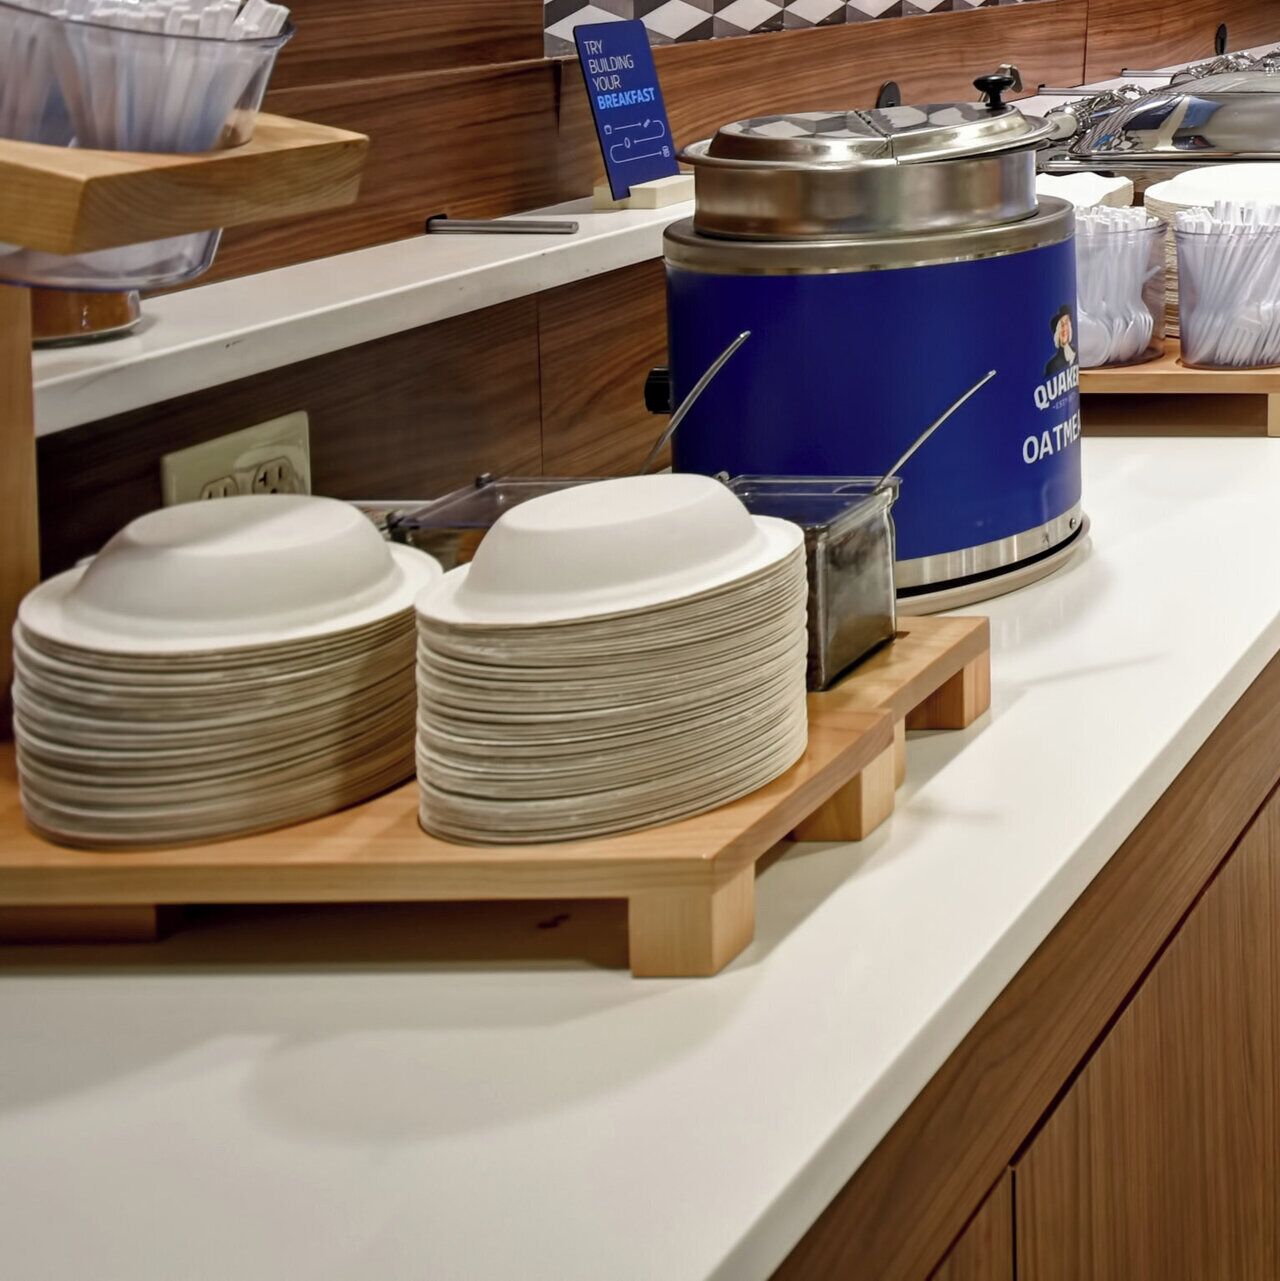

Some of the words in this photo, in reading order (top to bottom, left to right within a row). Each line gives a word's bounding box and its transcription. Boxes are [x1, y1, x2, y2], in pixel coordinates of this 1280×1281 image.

[584, 40, 603, 56] TRY
[588, 55, 634, 74] BUILDING
[593, 74, 622, 92] YOUR
[597, 86, 656, 110] BREAKFAST
